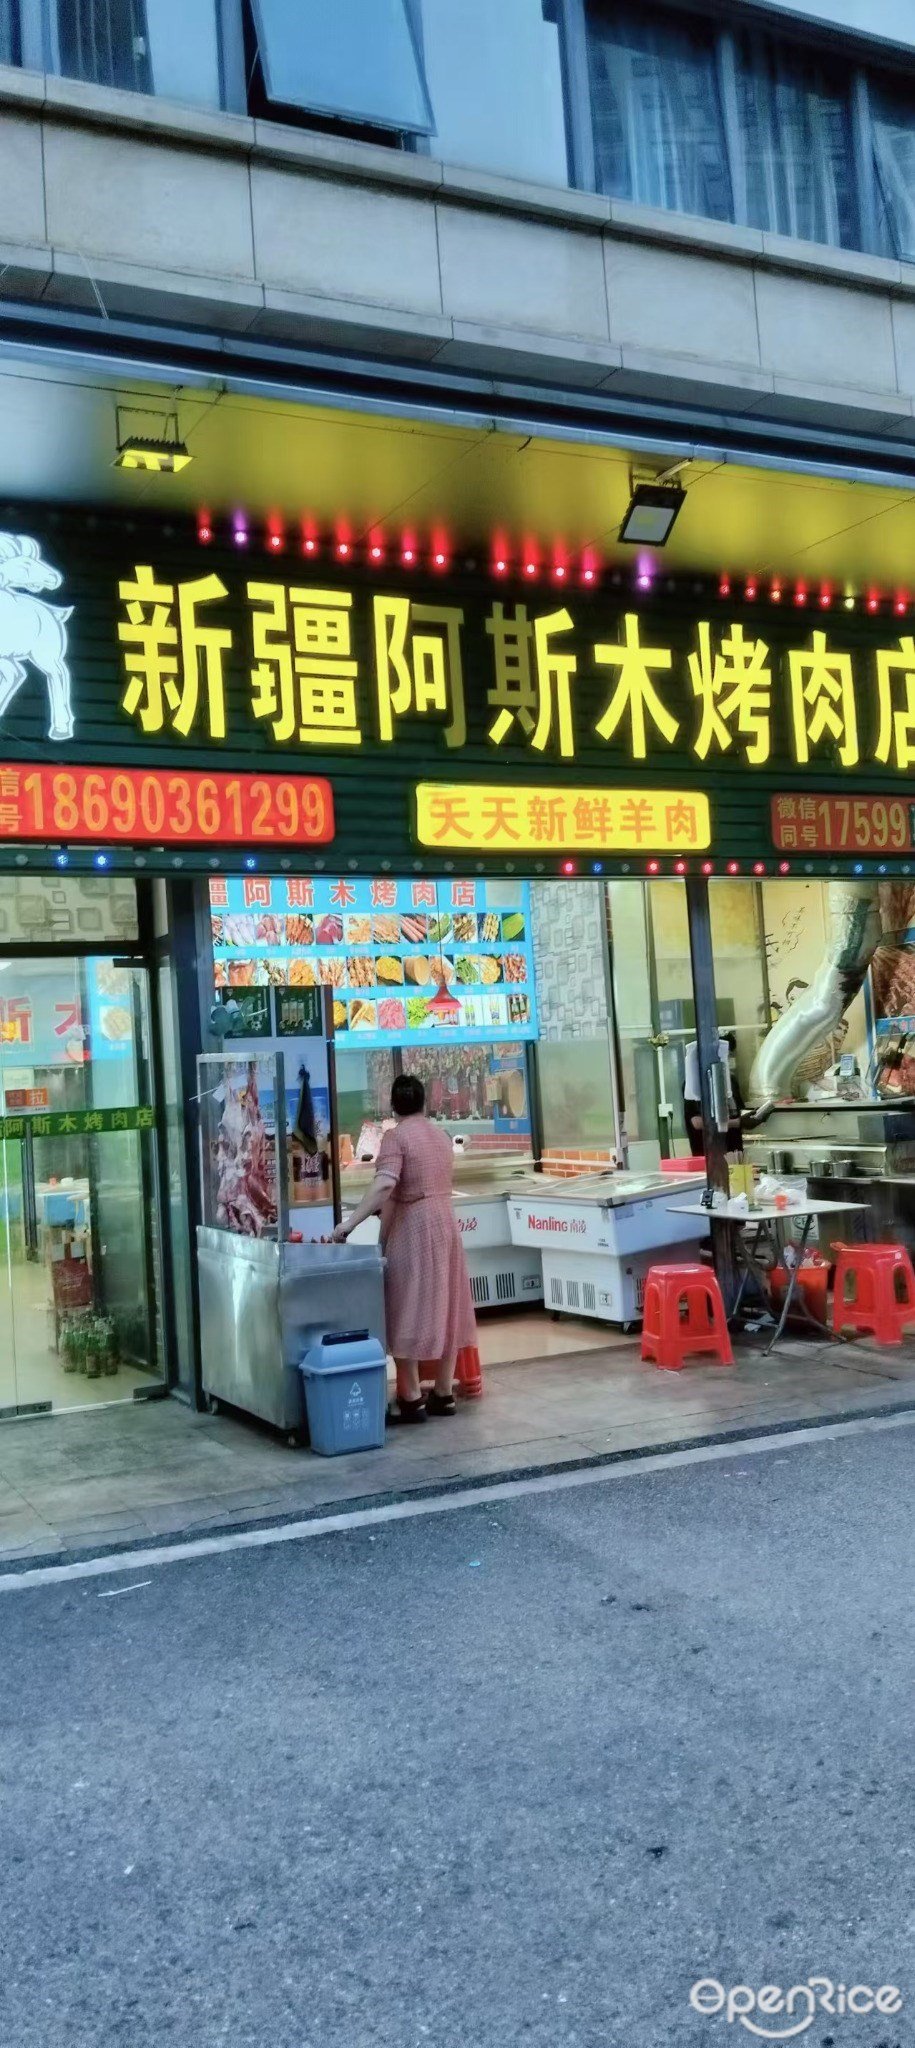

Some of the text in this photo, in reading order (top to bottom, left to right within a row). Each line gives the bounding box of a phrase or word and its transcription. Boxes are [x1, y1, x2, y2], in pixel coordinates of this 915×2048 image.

[118, 565, 915, 769] 新疆阿斯木烤肉店
[24, 772, 328, 837] 18690361299
[430, 795, 698, 843] 天天新鲜羊肉
[777, 797, 816, 820] 微信
[818, 800, 906, 847] 17599
[780, 825, 819, 847] 同号
